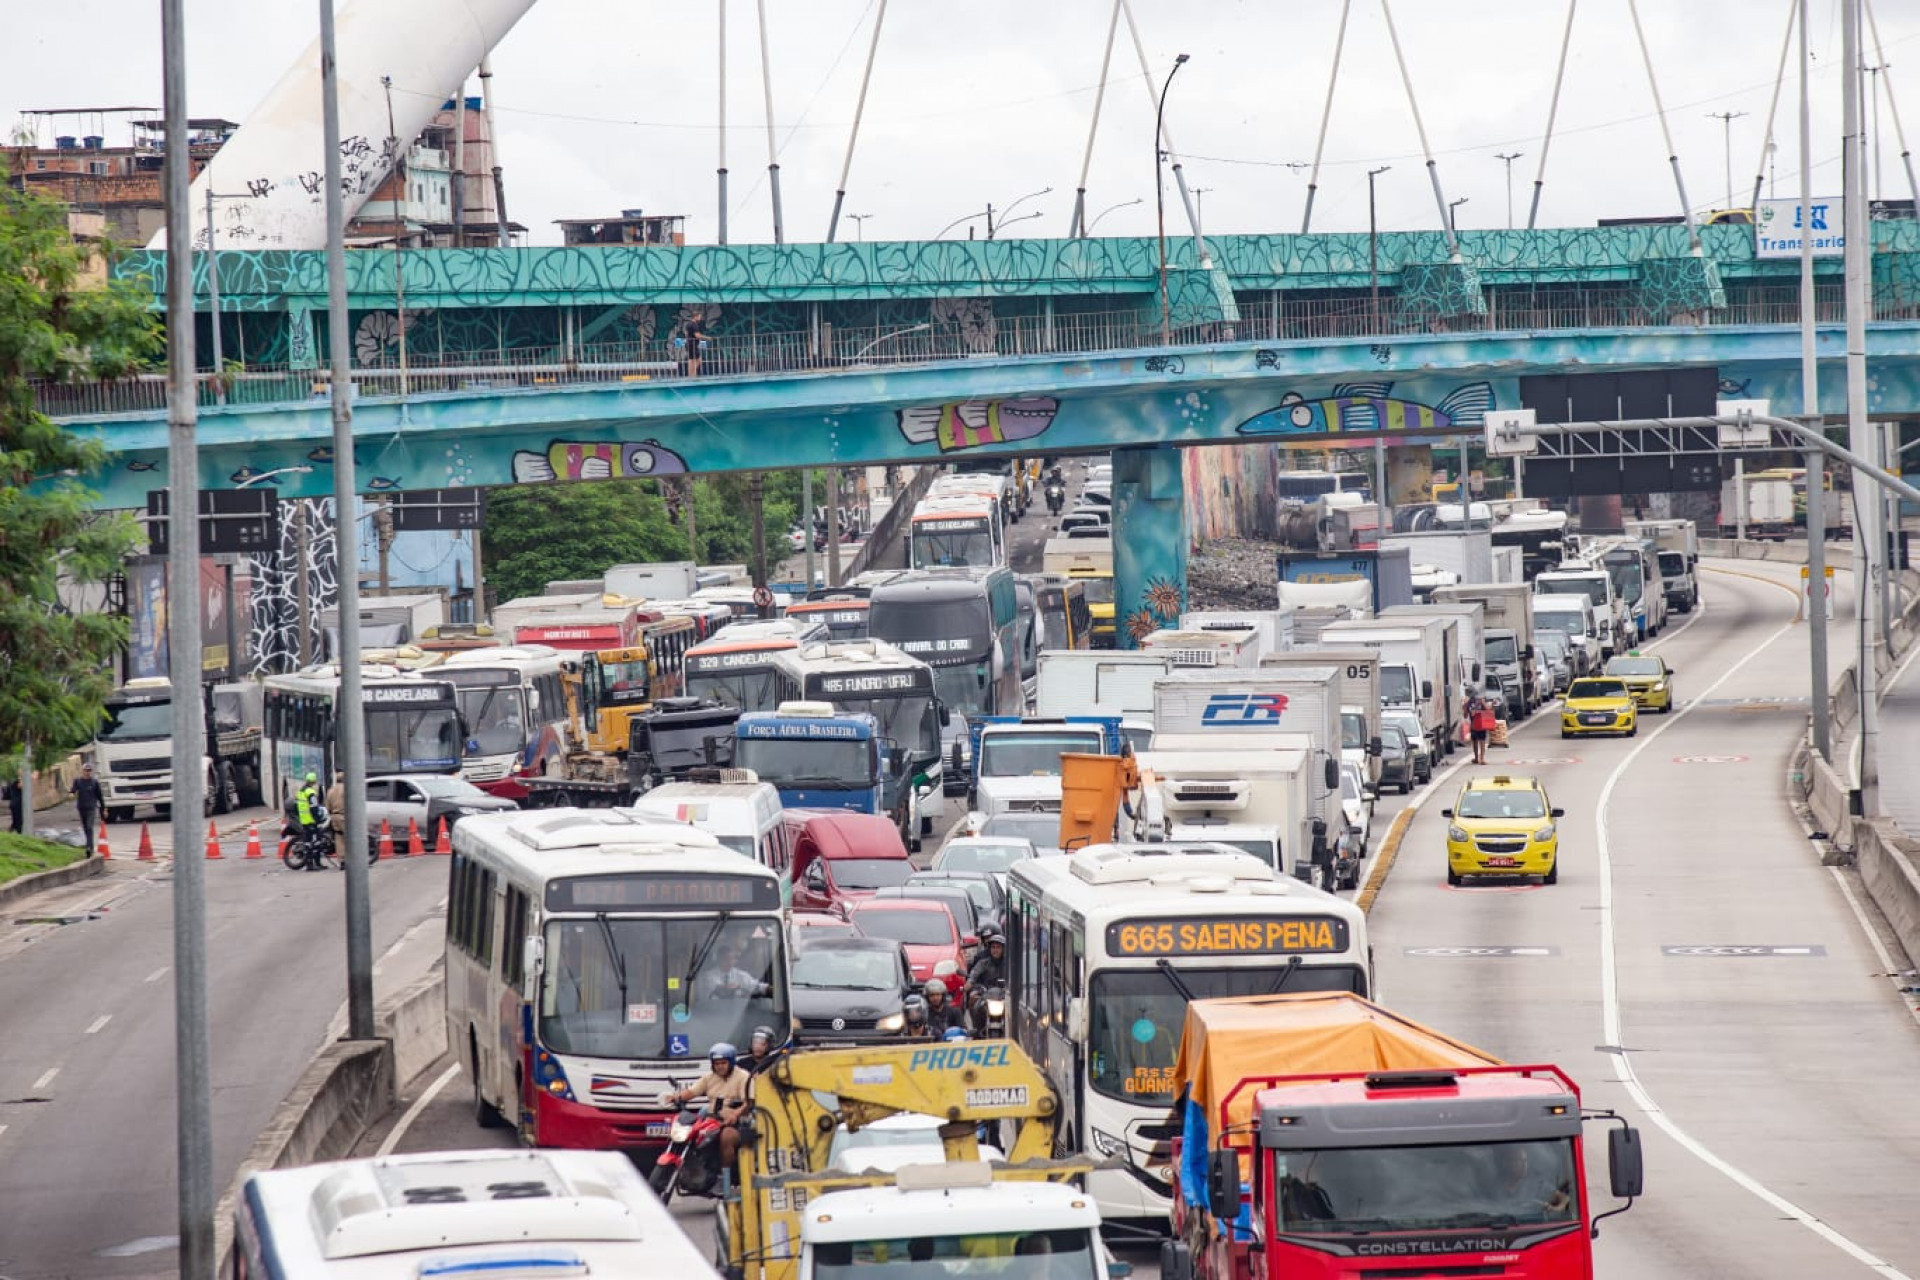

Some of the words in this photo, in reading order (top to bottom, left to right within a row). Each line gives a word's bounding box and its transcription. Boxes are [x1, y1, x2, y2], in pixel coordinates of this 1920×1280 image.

[1347, 665, 1370, 678] 05
[375, 687, 439, 701] CANDELARIA
[748, 724, 776, 736] FORÇA
[809, 723, 857, 737] BRASILEIRA
[1121, 924, 1173, 952] 665
[1179, 922, 1262, 951] SAENS
[1266, 921, 1334, 949] PENA
[909, 1044, 1011, 1072] PROSEL
[1358, 1239, 1506, 1255] CONSTELLATION
